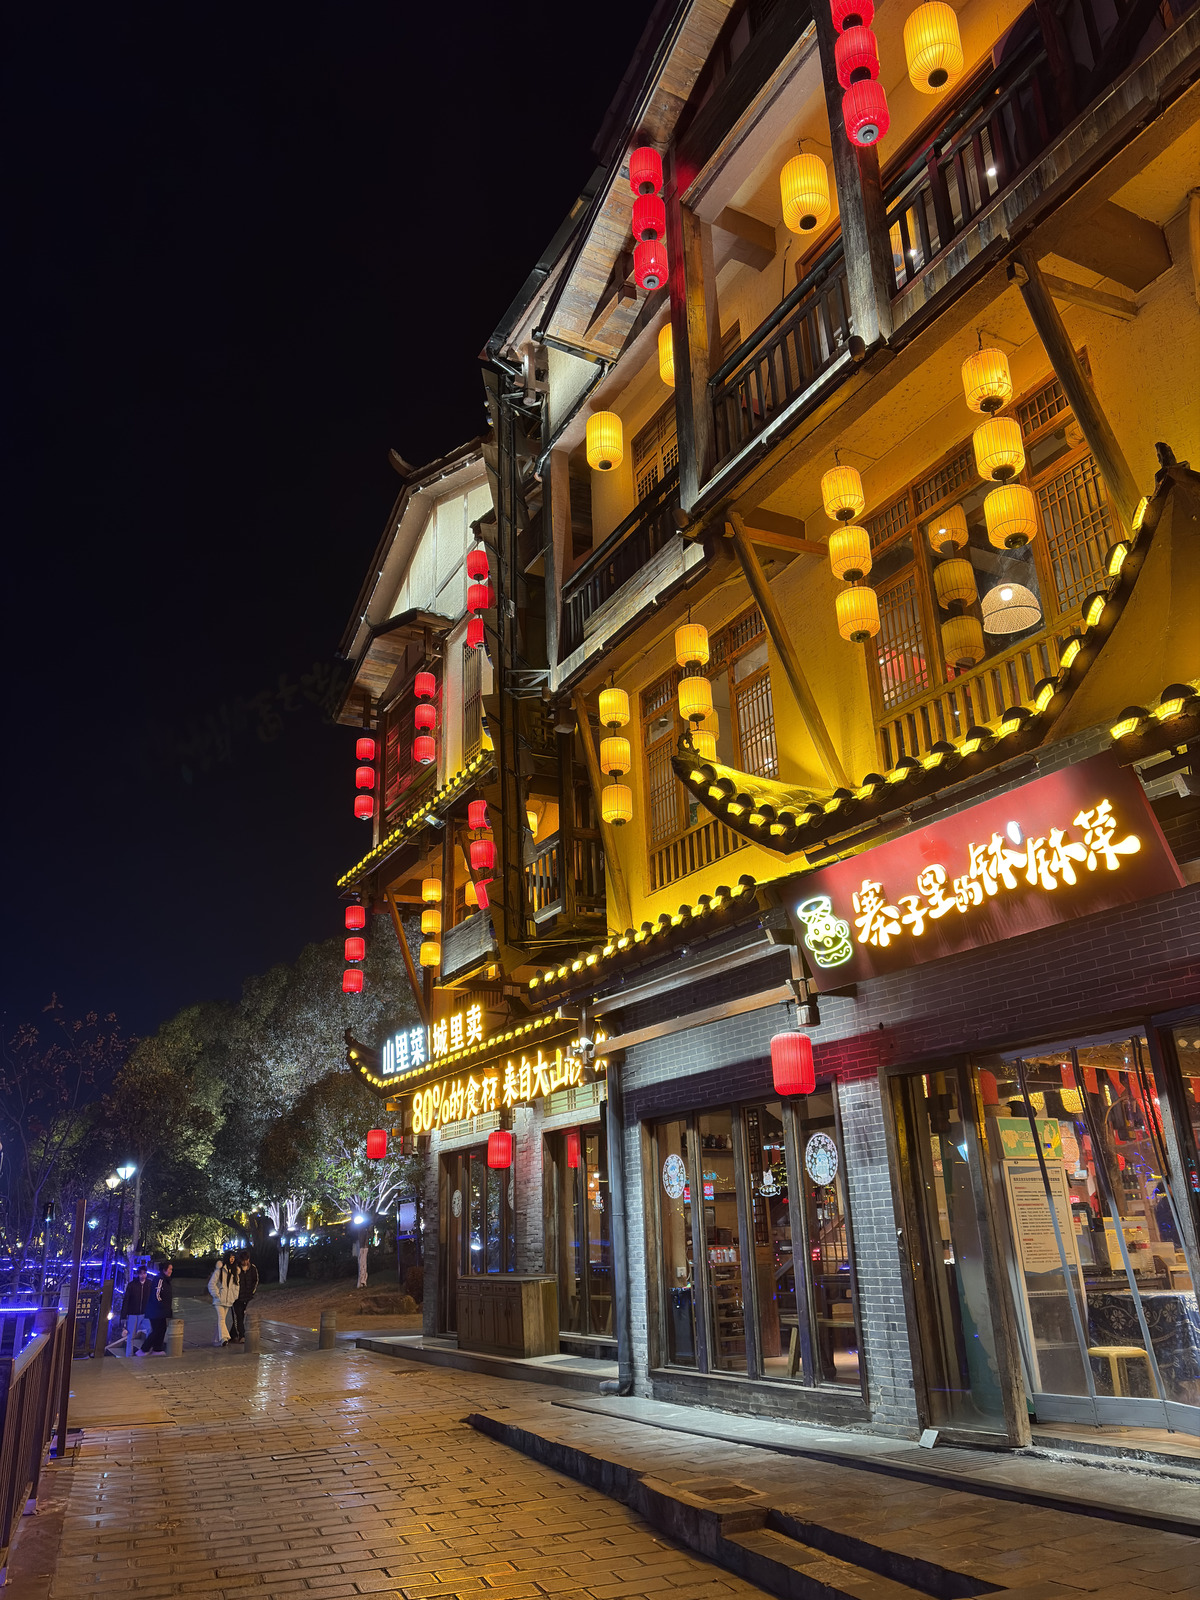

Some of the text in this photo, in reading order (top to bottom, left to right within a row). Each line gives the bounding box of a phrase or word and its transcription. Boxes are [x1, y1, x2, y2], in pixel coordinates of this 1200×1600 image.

[851, 798, 1141, 948] 寨子里的钵钵菜
[382, 1004, 483, 1075] 山里菜 城里卖
[412, 1075, 499, 1134] 80%的食材
